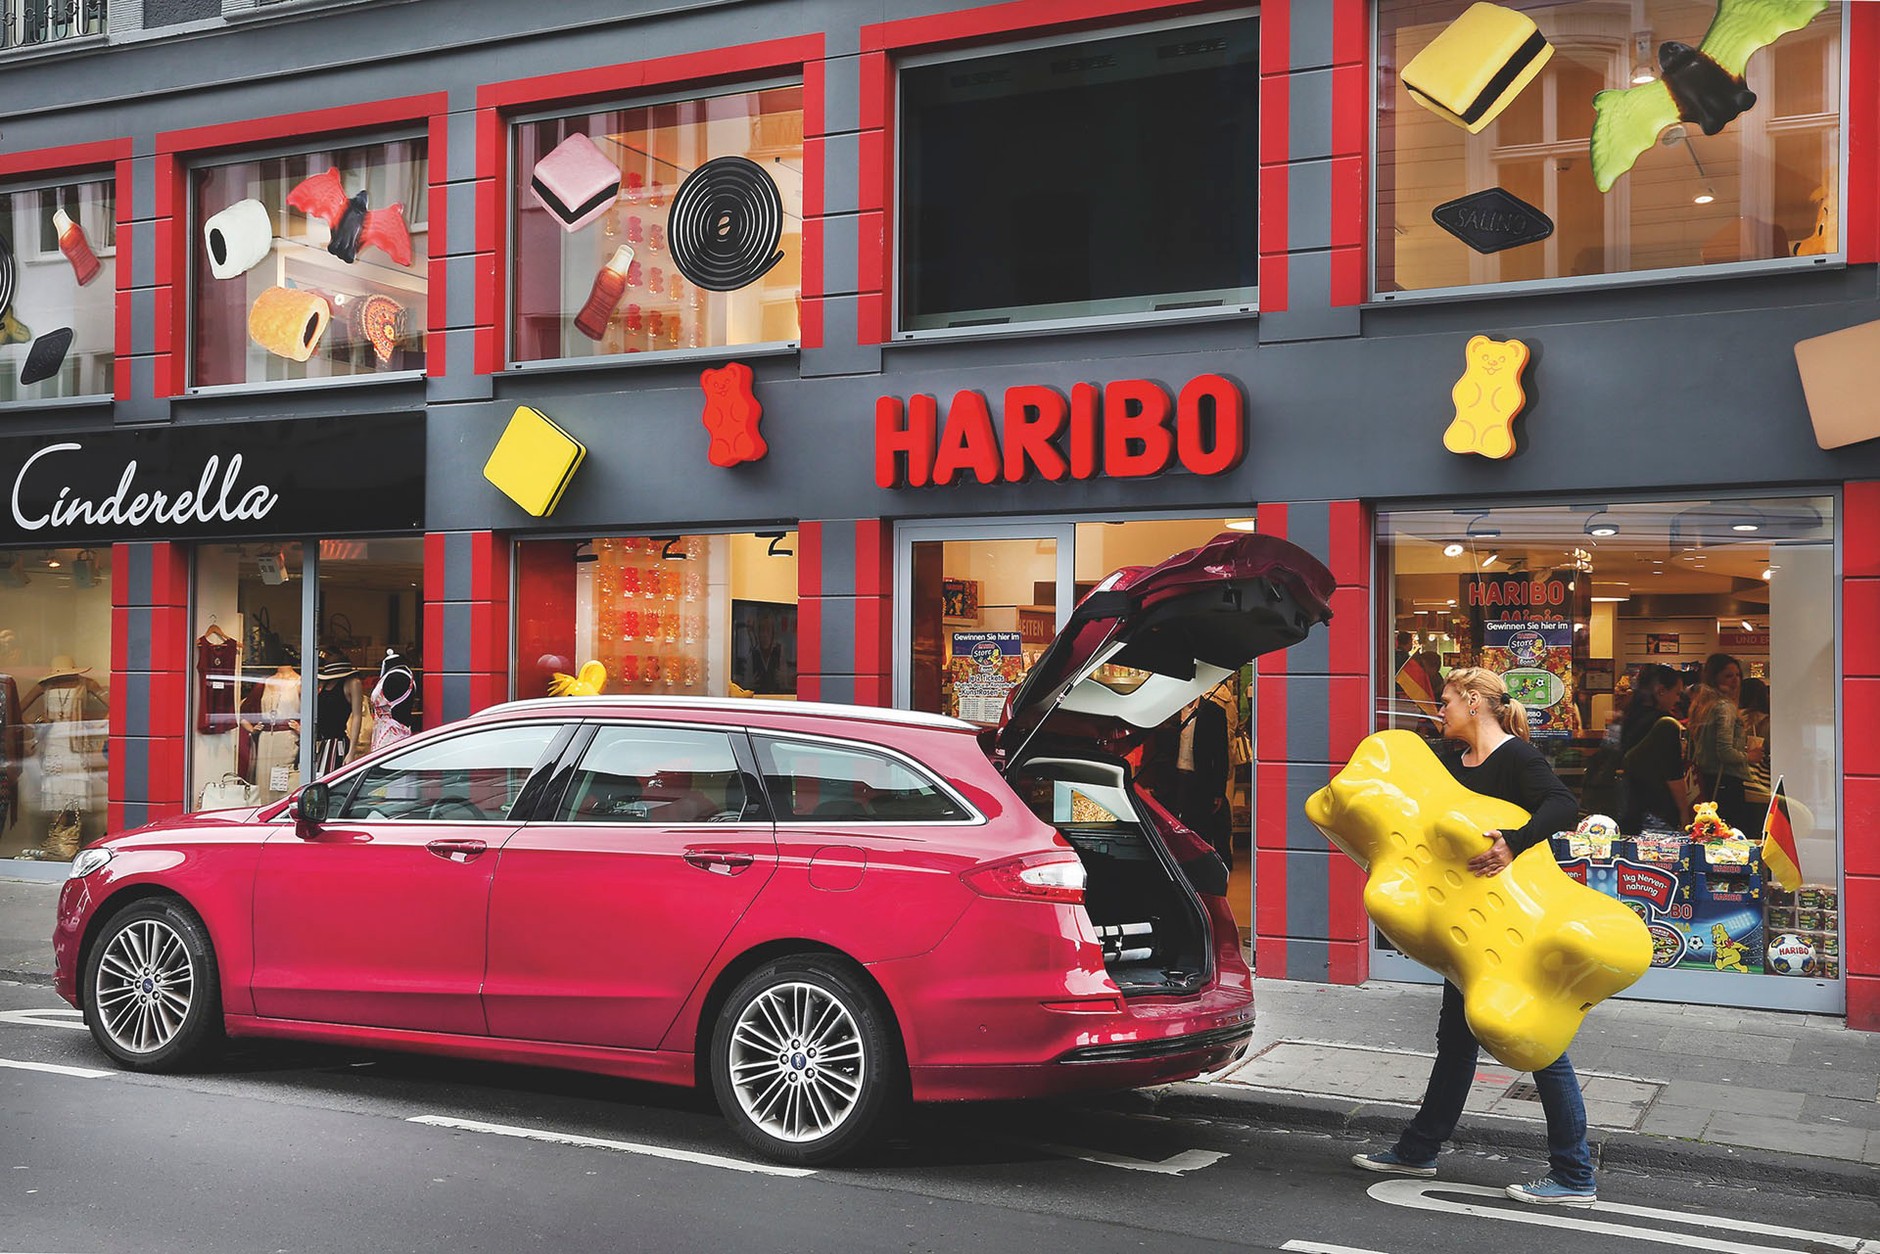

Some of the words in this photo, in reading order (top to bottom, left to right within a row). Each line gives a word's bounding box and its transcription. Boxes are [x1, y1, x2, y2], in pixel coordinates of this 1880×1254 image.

[1456, 207, 1527, 235] SALINO
[875, 373, 1243, 490] HARIBO
[11, 443, 279, 530] Cinderella
[1469, 581, 1564, 606] HARIBO
[1019, 619, 1044, 637] EITEN
[1486, 621, 1526, 631] Gewinnen
[1527, 621, 1539, 630] Sie
[1541, 621, 1556, 630] hier
[1558, 621, 1568, 630] im
[954, 633, 986, 641] Gewinnen
[986, 633, 997, 641] Sie
[997, 633, 1010, 641] hier
[1011, 633, 1020, 641] im
[1511, 639, 1533, 649] Store
[1736, 635, 1757, 644] UND
[974, 649, 992, 657] Store
[1622, 874, 1636, 882] 1kg
[1637, 873, 1668, 889] Nerven-
[1626, 883, 1659, 897] nahrung
[1778, 947, 1809, 955] HARIBO
